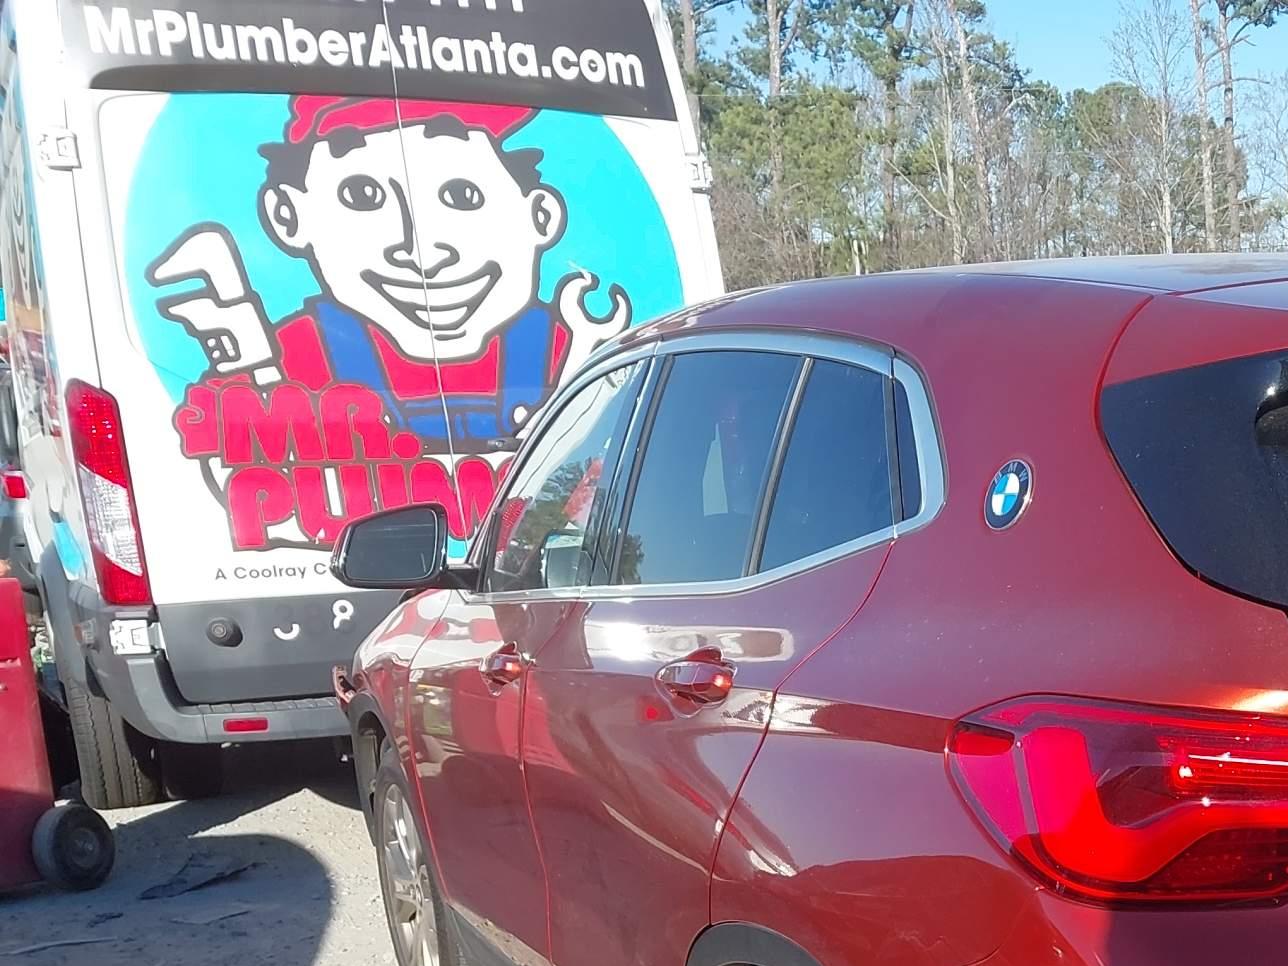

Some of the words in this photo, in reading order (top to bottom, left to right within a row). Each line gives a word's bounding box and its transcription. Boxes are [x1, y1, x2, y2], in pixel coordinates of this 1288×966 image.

[83, 5, 645, 88] MrPlumberAtlanta.com
[219, 383, 421, 464] MR.
[215, 568, 227, 580] A
[234, 565, 307, 579] Coolray
